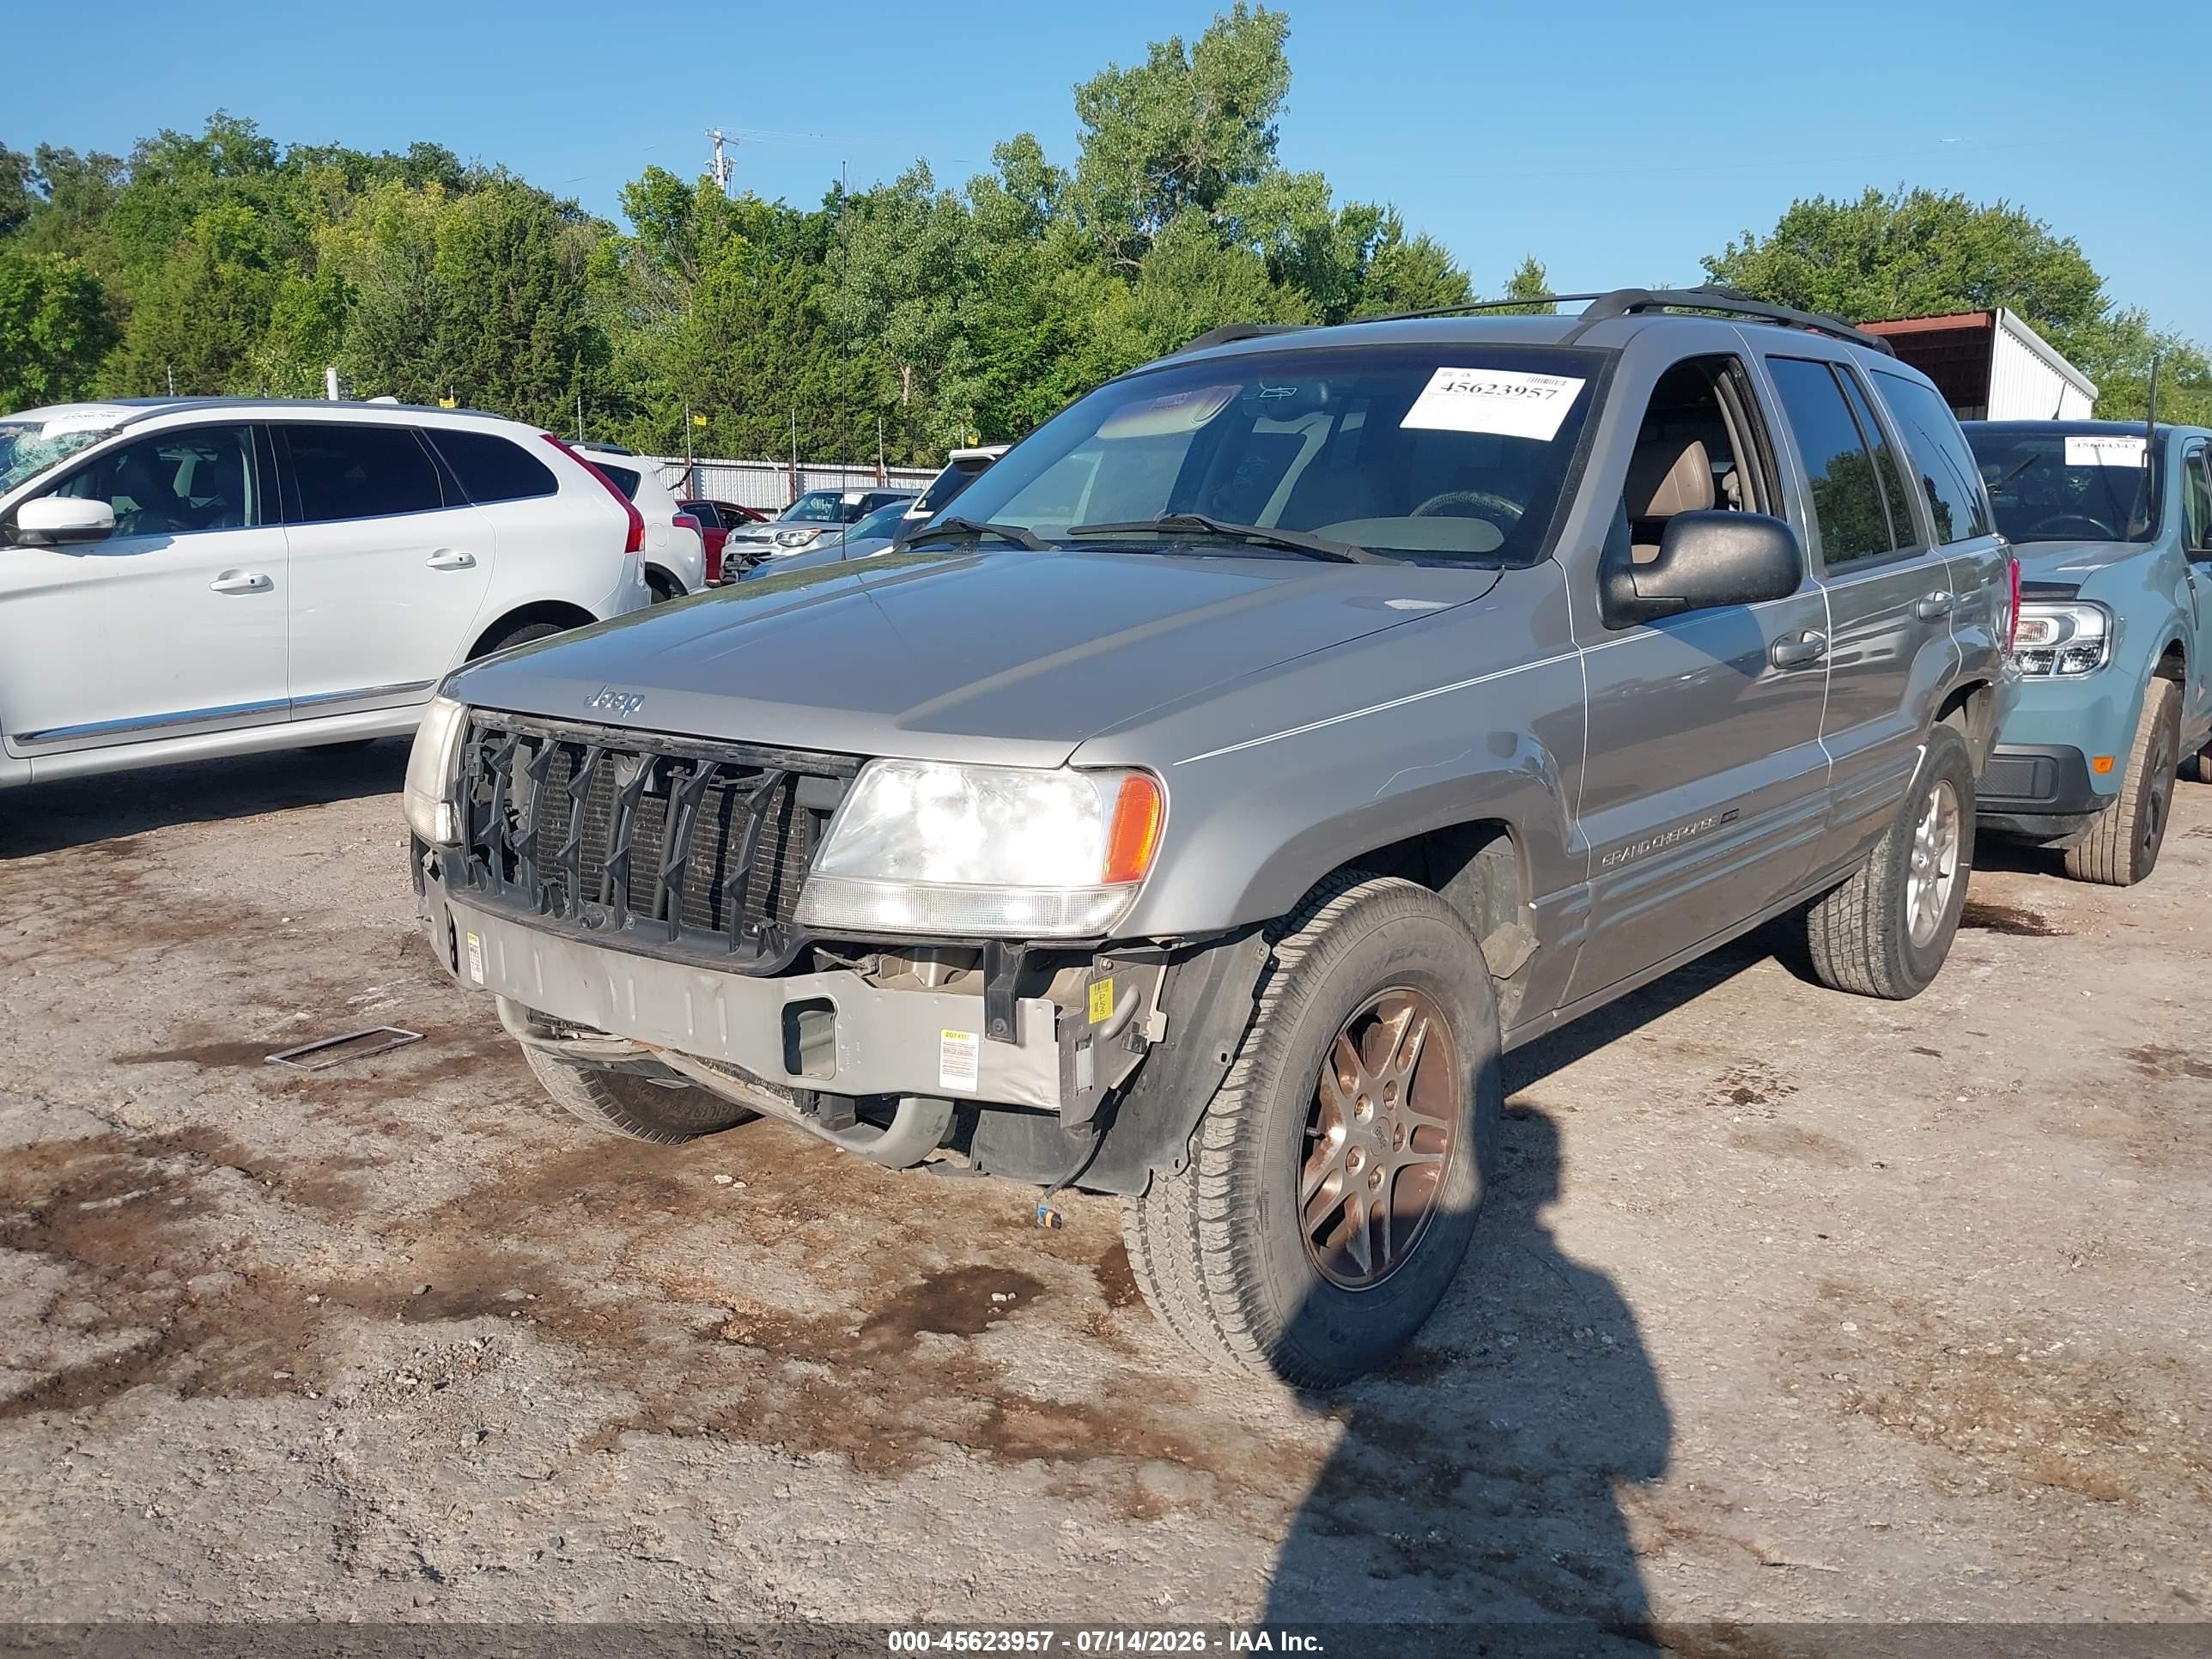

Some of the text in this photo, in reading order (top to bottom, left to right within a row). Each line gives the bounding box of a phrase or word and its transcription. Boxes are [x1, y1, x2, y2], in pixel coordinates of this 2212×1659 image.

[1440, 380, 1559, 400] 45623957
[585, 685, 645, 719] Jeep
[1601, 817, 1717, 866] GRAND CHEROKEE
